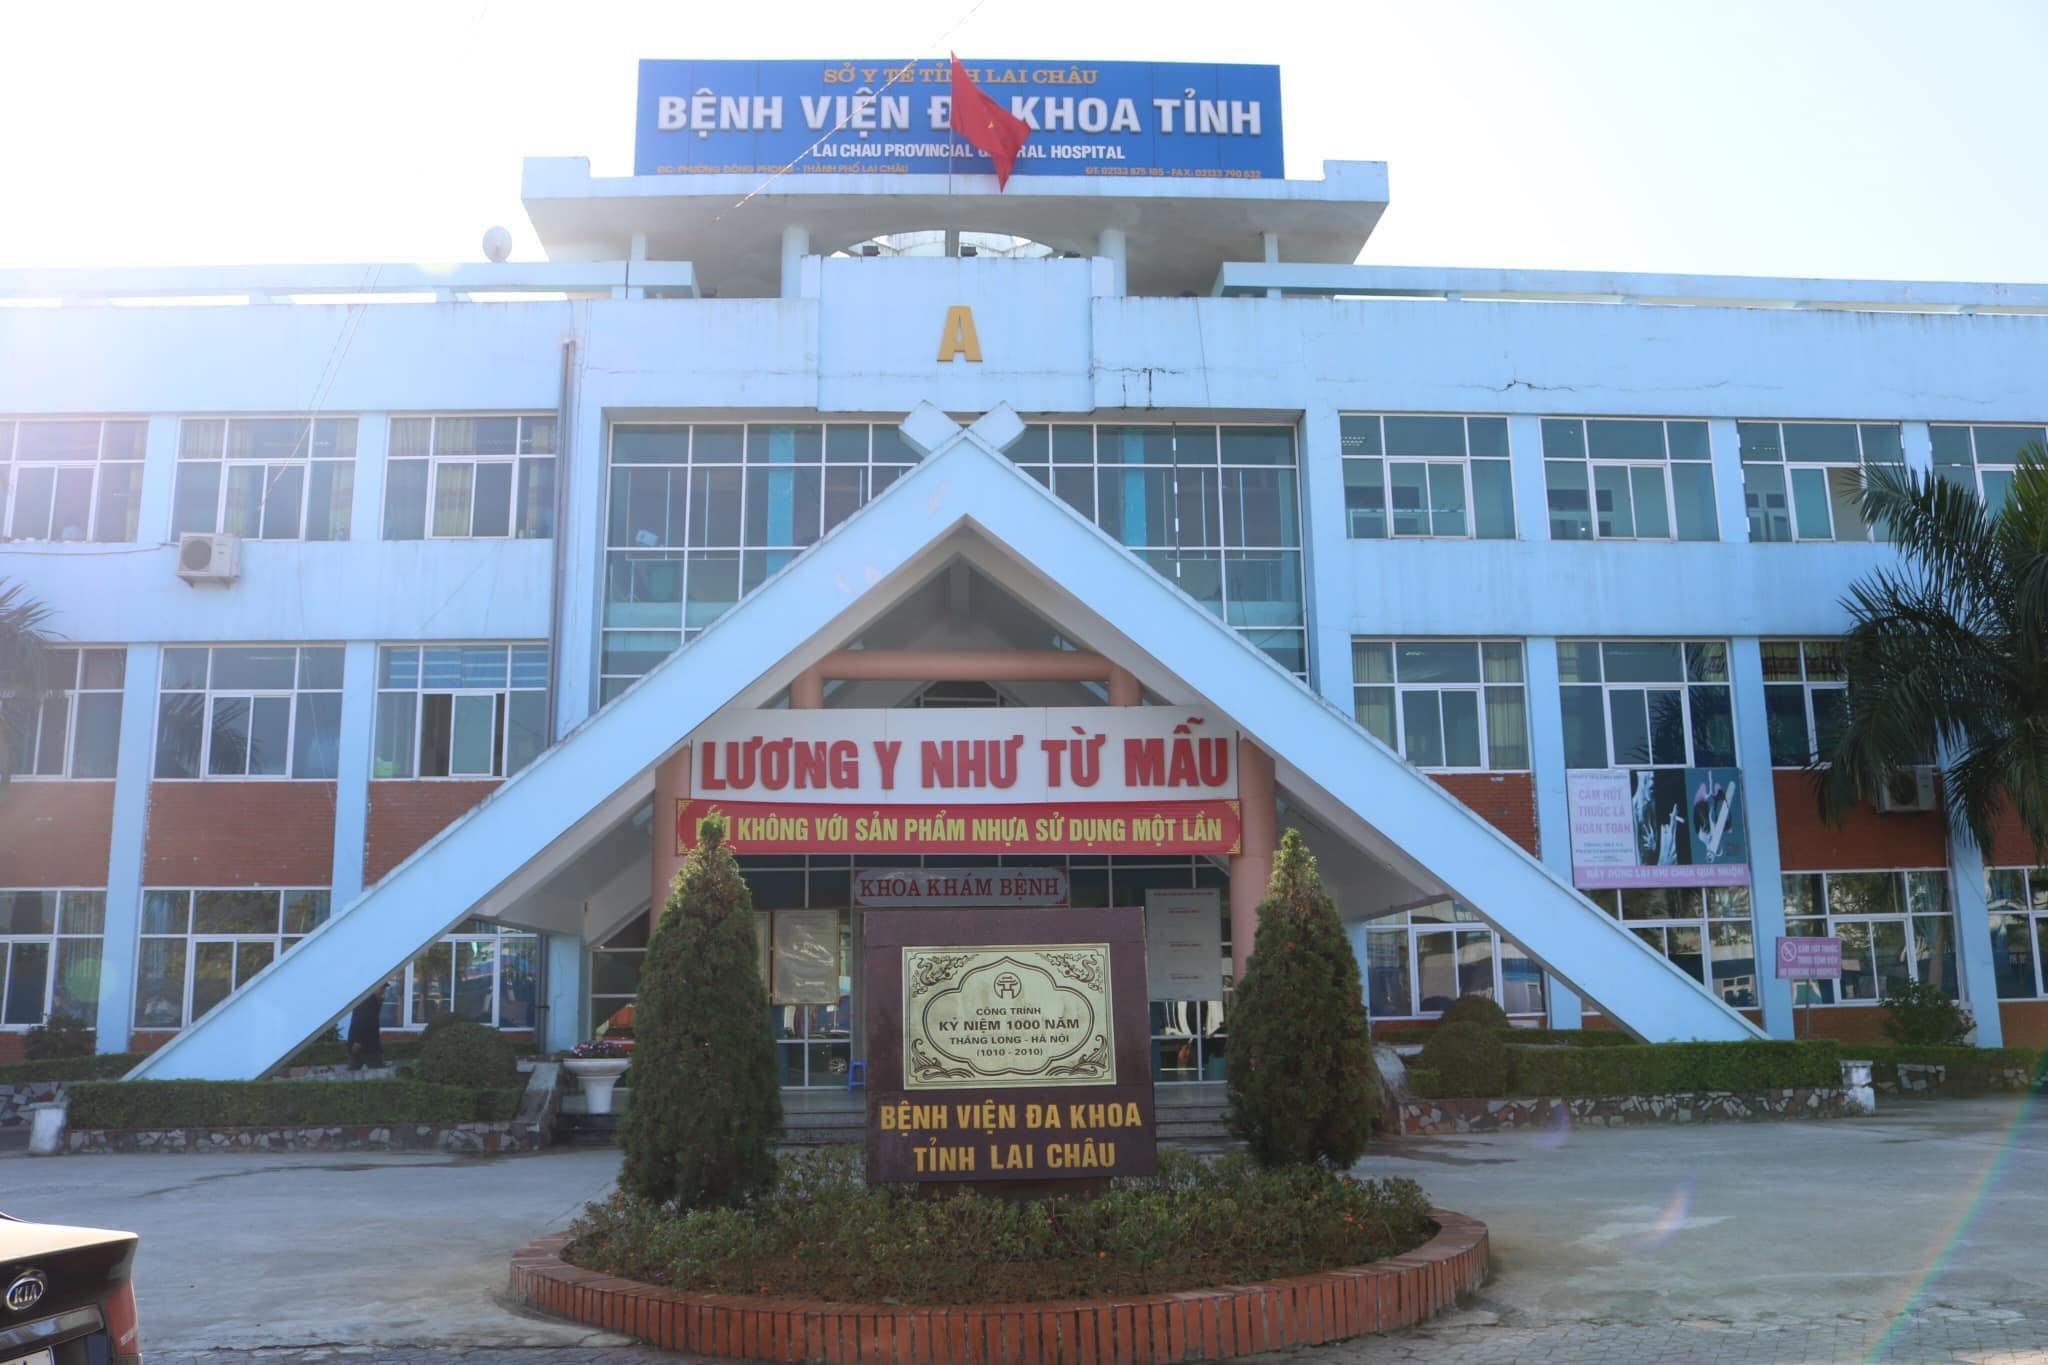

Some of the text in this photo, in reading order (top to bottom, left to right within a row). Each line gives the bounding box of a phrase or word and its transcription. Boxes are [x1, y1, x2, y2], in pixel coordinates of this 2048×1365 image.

[823, 63, 856, 84] SỞ
[861, 68, 878, 84] Y
[883, 63, 915, 84] TẾ
[986, 69, 1028, 84] LAI
[1032, 66, 1097, 84] CHÂU
[657, 88, 783, 138] BỆNH
[800, 87, 910, 138] VIỆN
[1011, 95, 1142, 132] KHOA
[1153, 88, 1261, 135] TỈNH
[813, 143, 1126, 159] LAI CHAU PROVINCIAL GRAL HOSPITAL
[936, 305, 983, 362] A
[700, 717, 1228, 790] LƯƠNG Y NHƯ TỪ MẪU
[737, 813, 809, 841] KHÔNG
[815, 812, 848, 841] VỚI
[855, 811, 898, 841] SẢN
[904, 809, 965, 841] PHẨM
[972, 816, 1028, 847] NHỰA
[1035, 811, 1065, 841] SỬ
[1070, 818, 1126, 847] DỤNG
[1132, 814, 1177, 847] MỘT
[1183, 810, 1222, 841] LẦN
[860, 872, 1060, 901] KHOA KHÁM BỆNH
[976, 1006, 1007, 1016] CÔNG
[939, 1016, 1079, 1034] KỶ NIỆM 1000 NĂM
[976, 1048, 1006, 1057] (1010
[1014, 1048, 1043, 1056] 2010)
[991, 1036, 1021, 1045] LONG
[880, 1100, 1142, 1136] BỆNH VIỆN ĐA KHOA
[913, 1137, 1116, 1172] TỈNH LAI CHÂU
[14, 1284, 38, 1304] KIA
